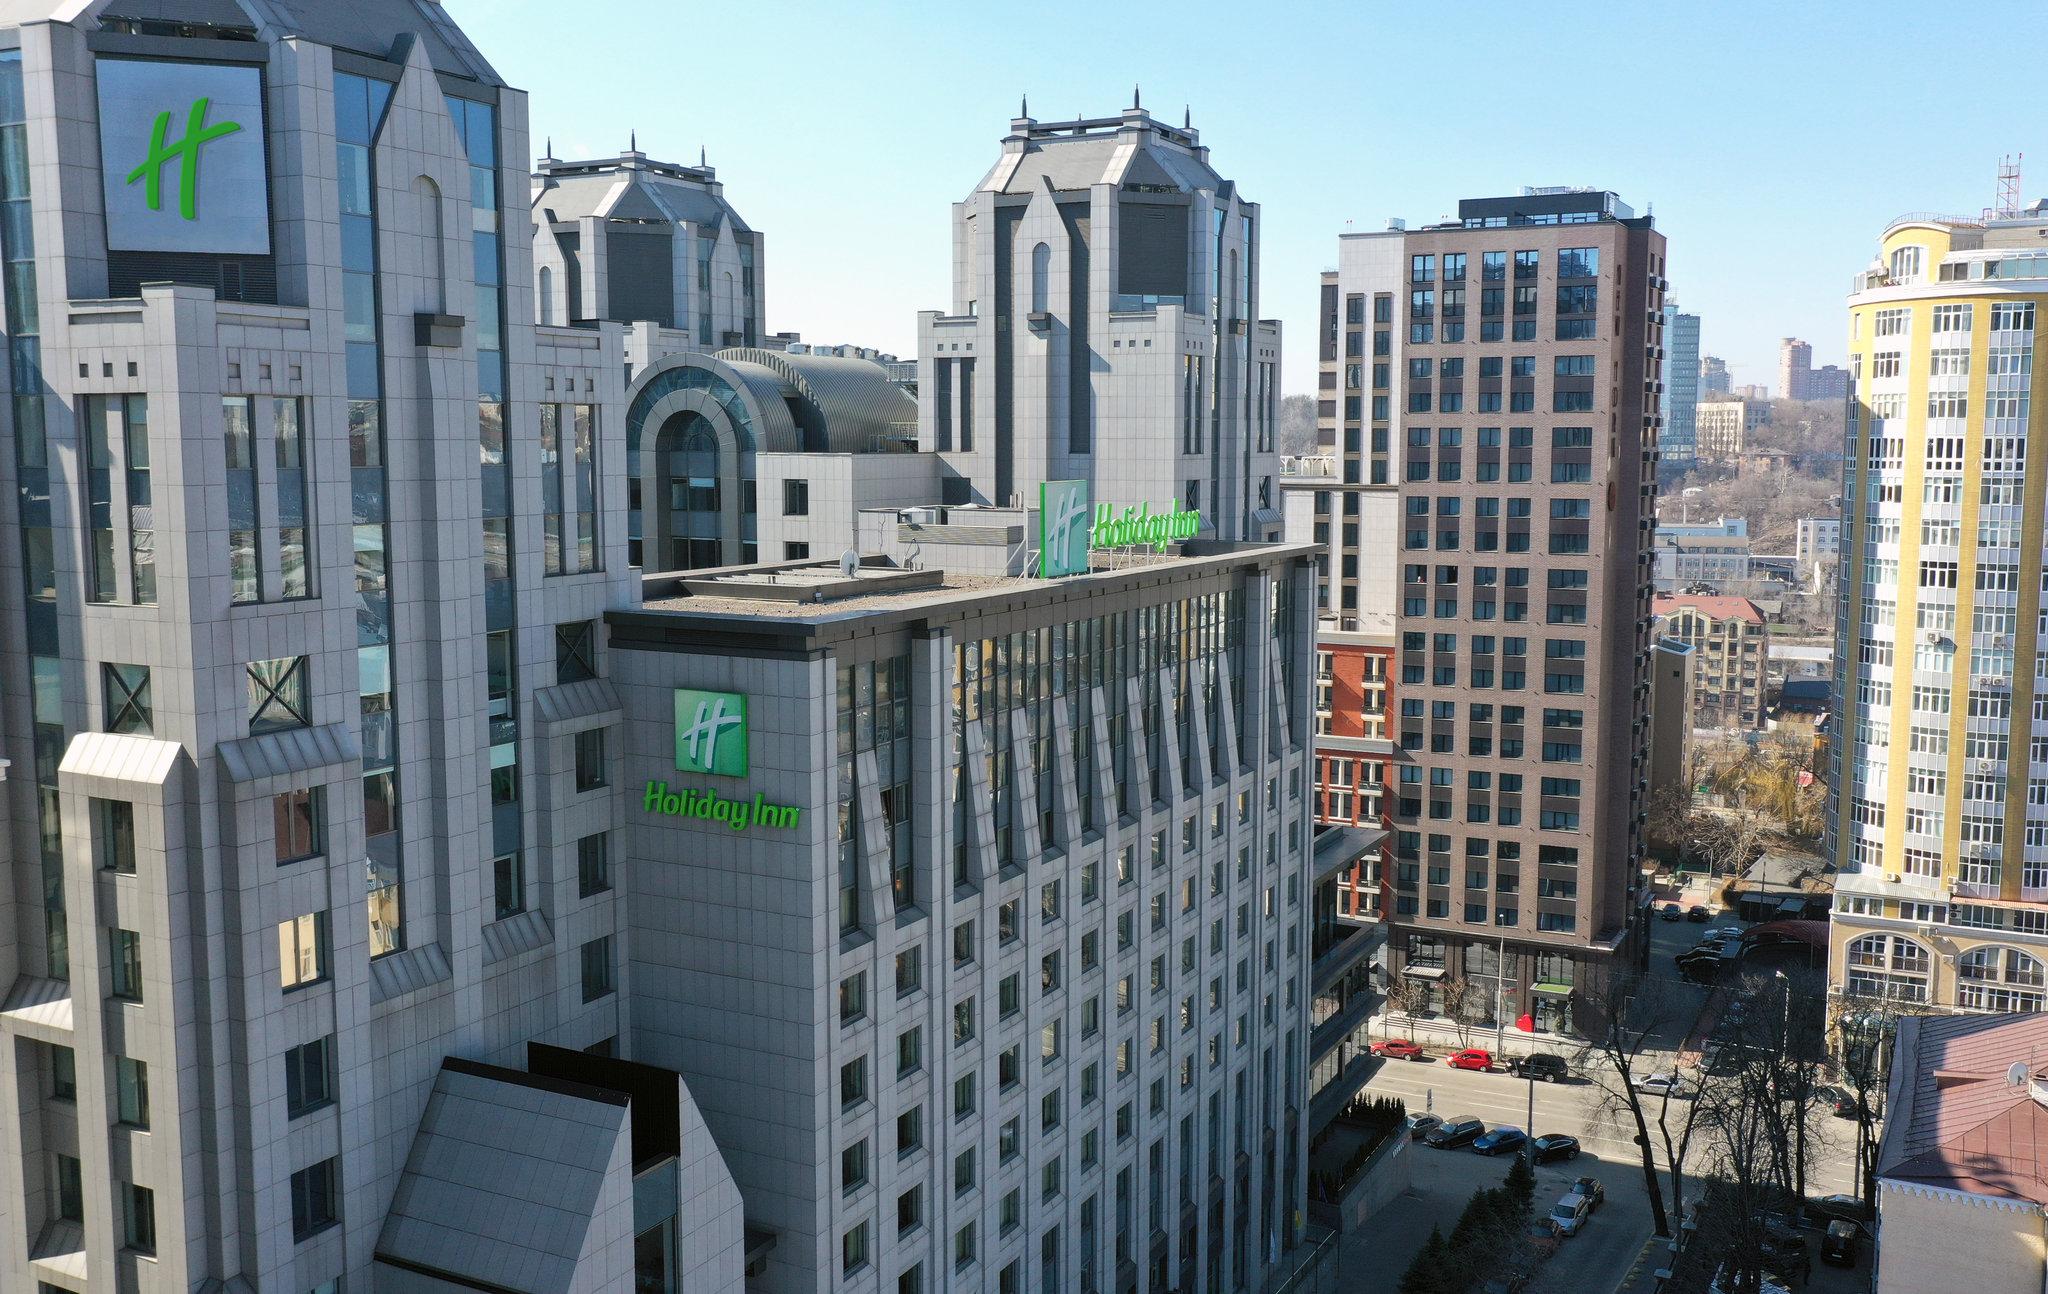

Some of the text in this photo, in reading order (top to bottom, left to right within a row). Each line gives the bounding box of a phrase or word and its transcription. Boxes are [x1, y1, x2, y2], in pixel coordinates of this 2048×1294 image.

[1093, 498, 1200, 553] Holiday Inn
[644, 780, 800, 830] Holiday Inn
